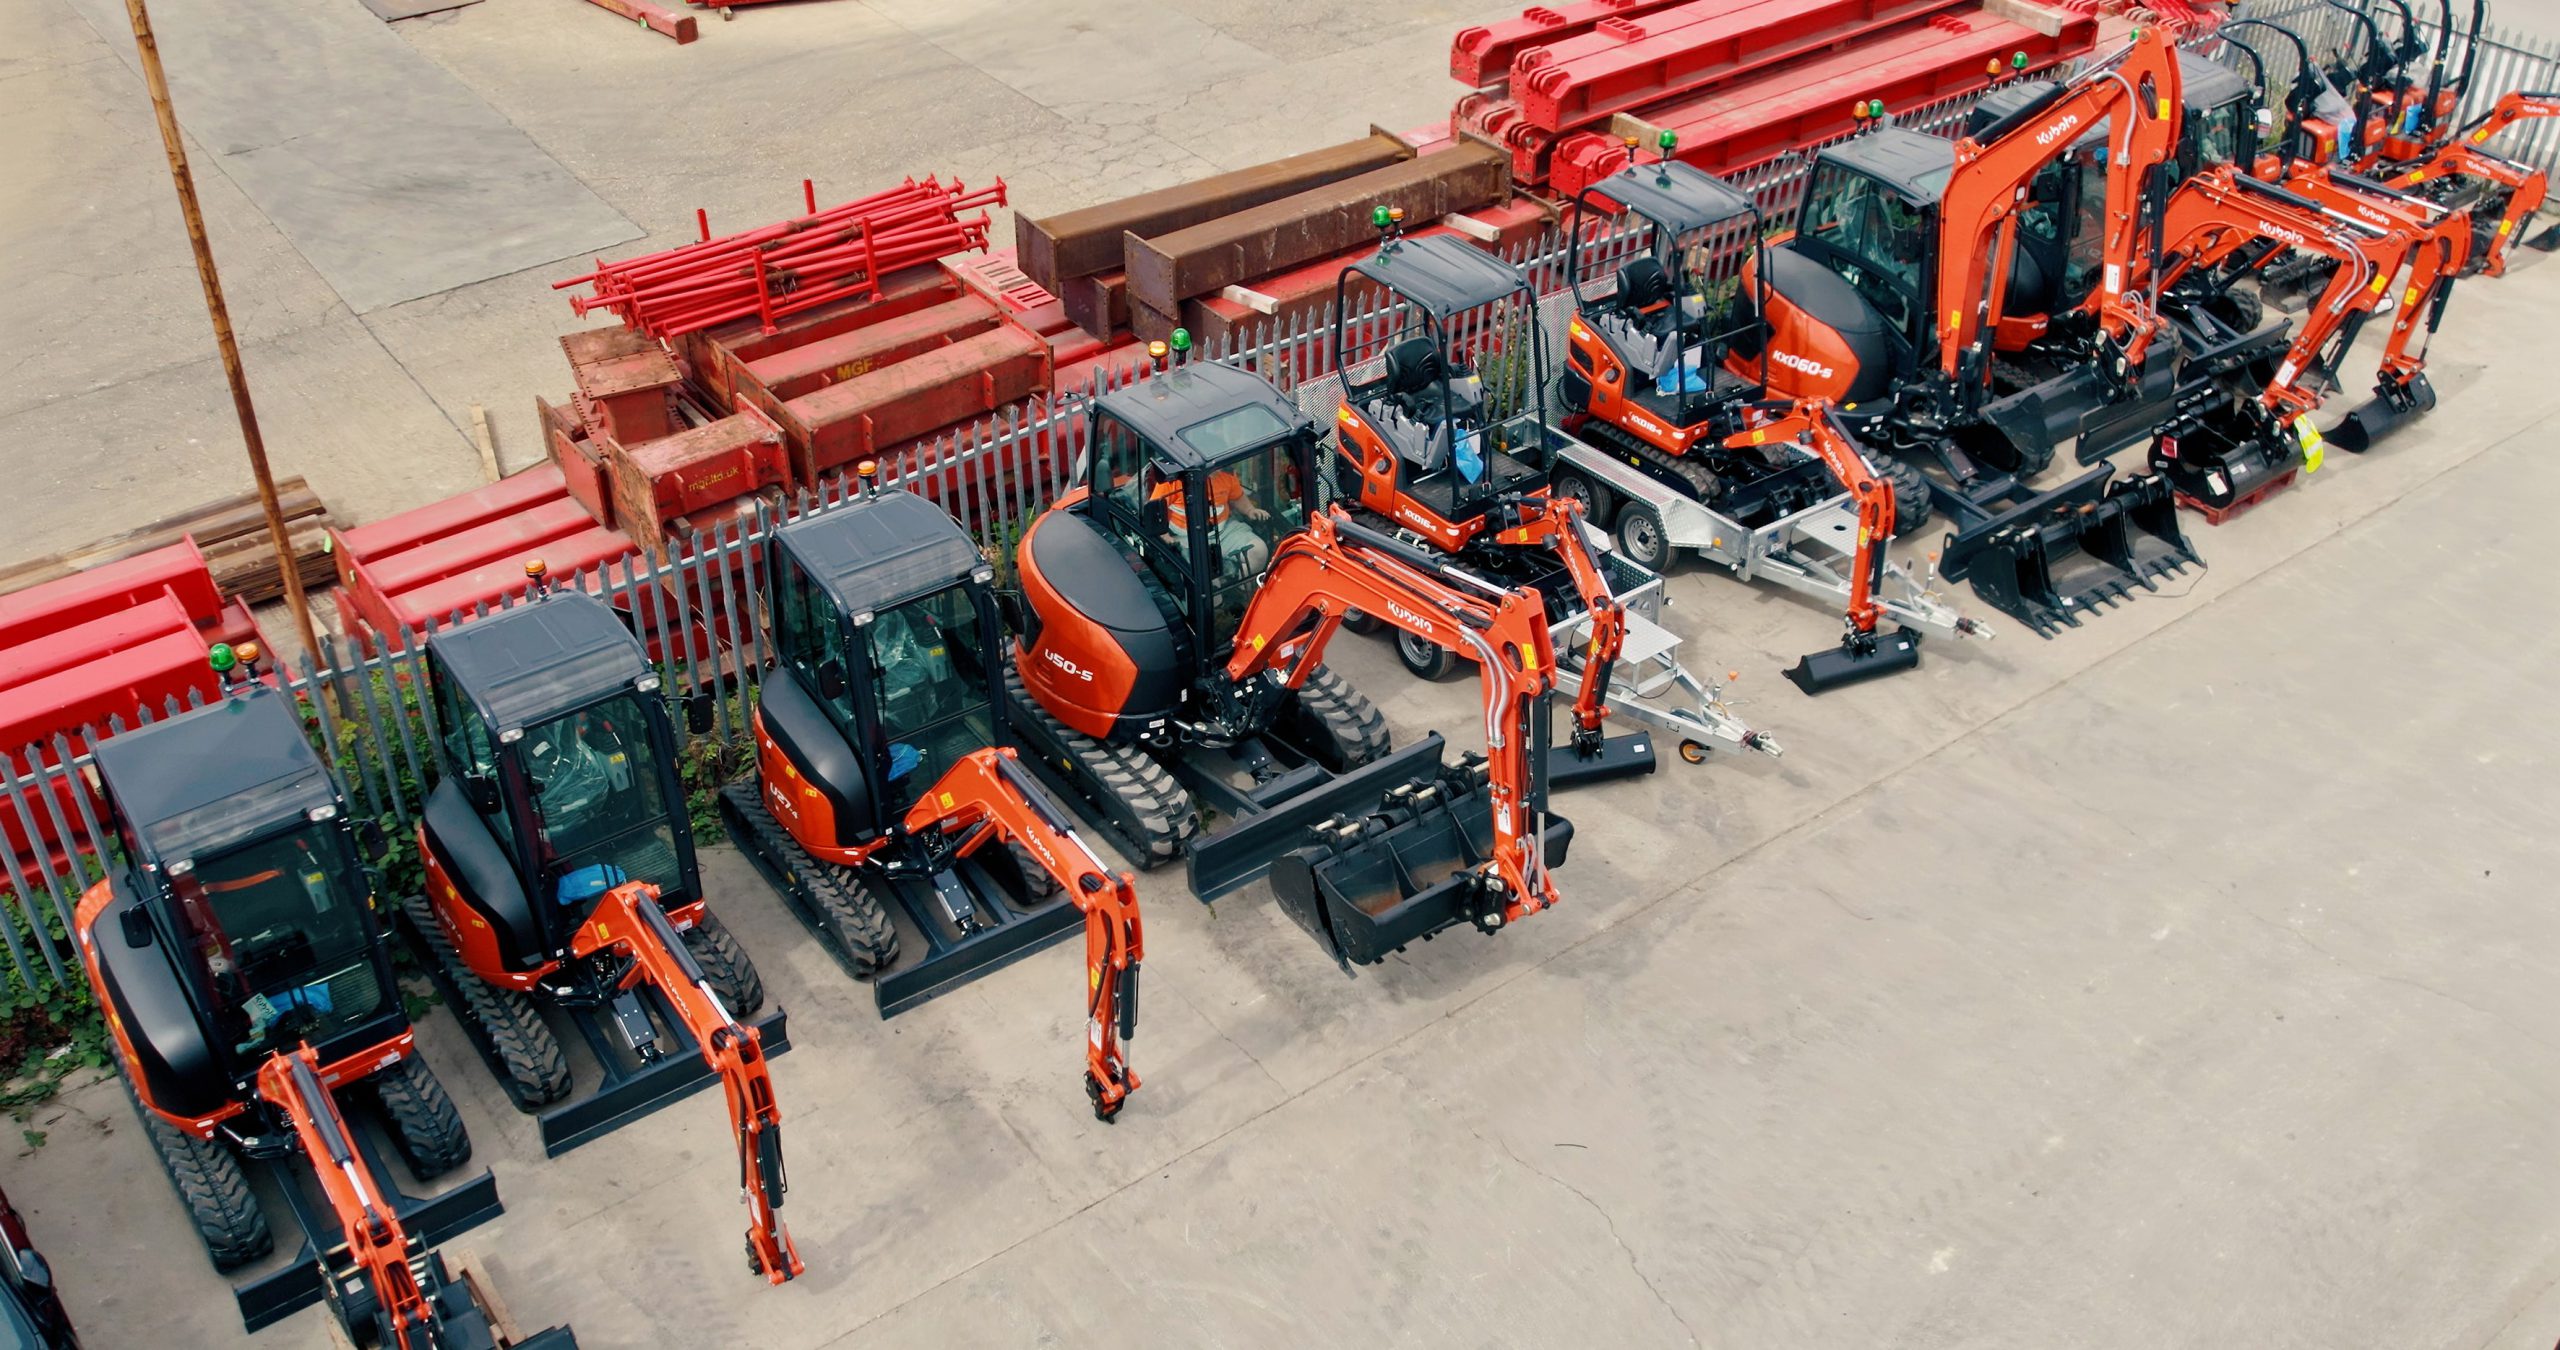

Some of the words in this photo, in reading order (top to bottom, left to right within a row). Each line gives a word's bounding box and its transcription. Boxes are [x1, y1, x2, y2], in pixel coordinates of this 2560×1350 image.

[2036, 114, 2078, 145] Kubota
[2259, 220, 2304, 244] Kubota
[2357, 205, 2390, 226] Kubota
[837, 359, 873, 380] MGF
[1824, 440, 1845, 477] Kubota
[1386, 599, 1432, 633] Kubota
[1045, 648, 1094, 682] U50-5
[770, 782, 799, 819] U27-4
[1026, 826, 1056, 867] Kubota
[664, 973, 692, 1019] Kubota
